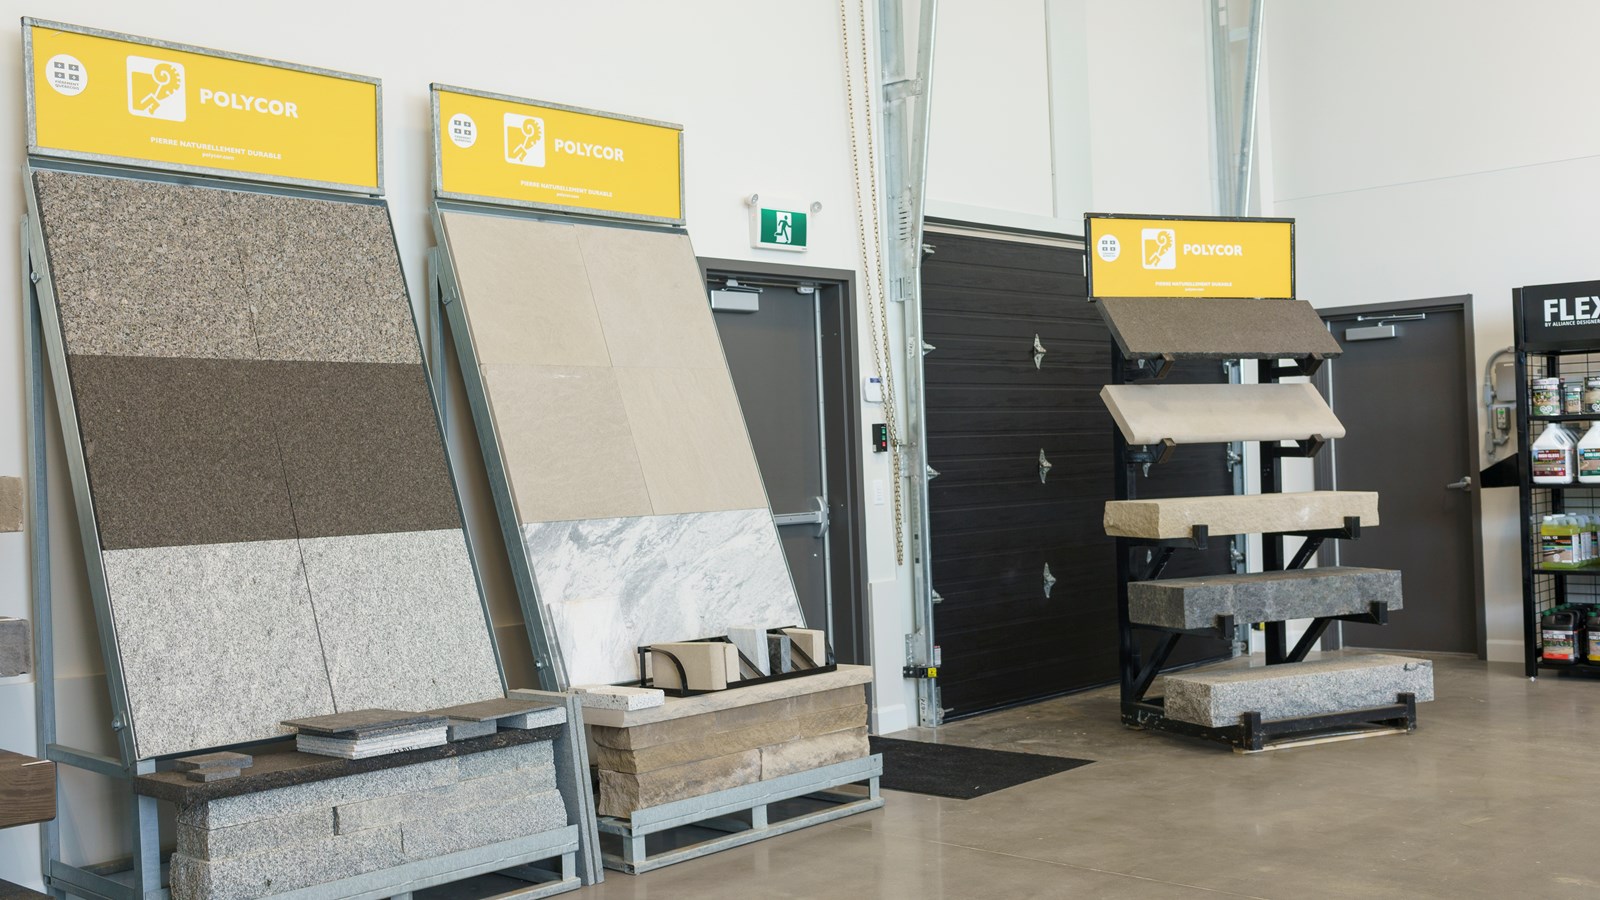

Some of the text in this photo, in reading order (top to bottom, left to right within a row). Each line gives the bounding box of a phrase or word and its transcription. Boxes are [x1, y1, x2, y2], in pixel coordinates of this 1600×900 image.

[200, 88, 299, 118] POLYCOR
[150, 136, 282, 160] PIERRE NATURELLEMENT DURABLE
[202, 152, 235, 161] polycor.com
[554, 138, 624, 162] POLYCOR
[520, 180, 613, 198] PIERRE NATURELLEMENT DURABLE
[1183, 243, 1243, 257] POLYCOR
